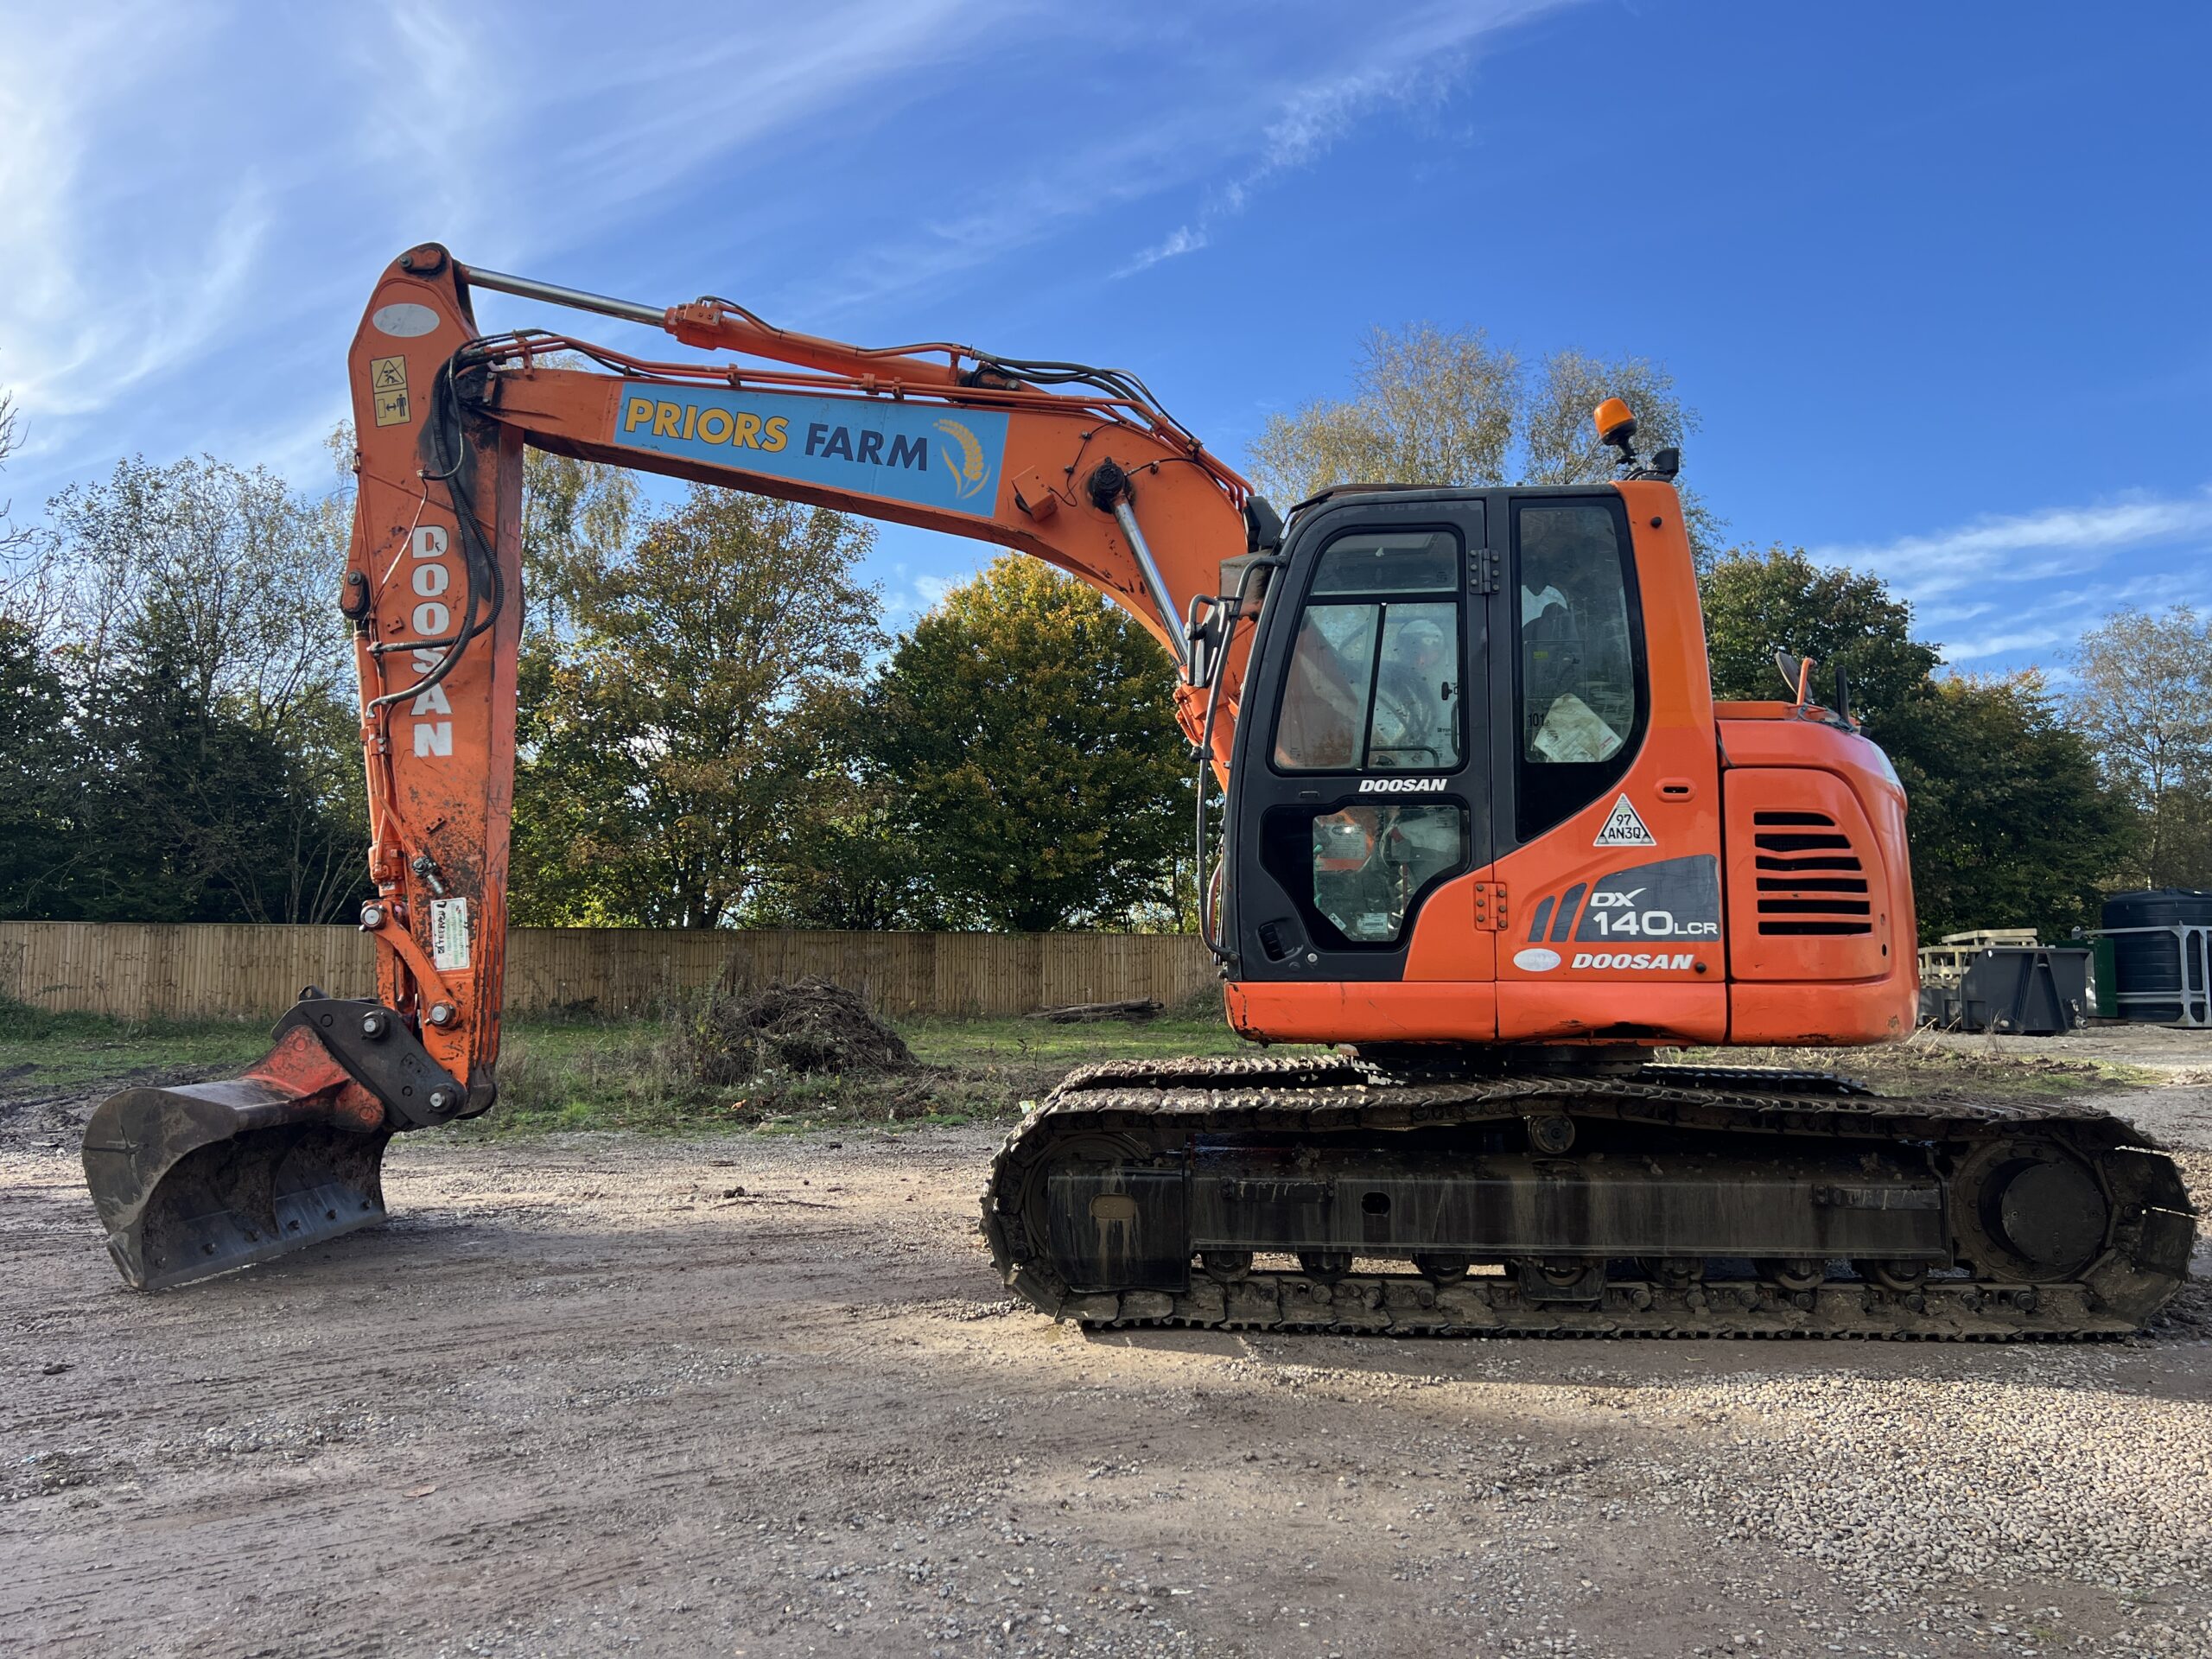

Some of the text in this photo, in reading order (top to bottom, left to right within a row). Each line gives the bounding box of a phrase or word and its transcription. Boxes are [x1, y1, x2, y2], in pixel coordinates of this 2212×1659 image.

[624, 397, 928, 471] PRIORS FARM
[410, 524, 454, 758] DOOSAN
[1358, 779, 1447, 792] DOOSAN
[1616, 814, 1631, 826] 97
[1608, 827, 1641, 839] AN3Q
[1590, 887, 1647, 907] DX
[1570, 952, 1694, 969] DOOSAN
